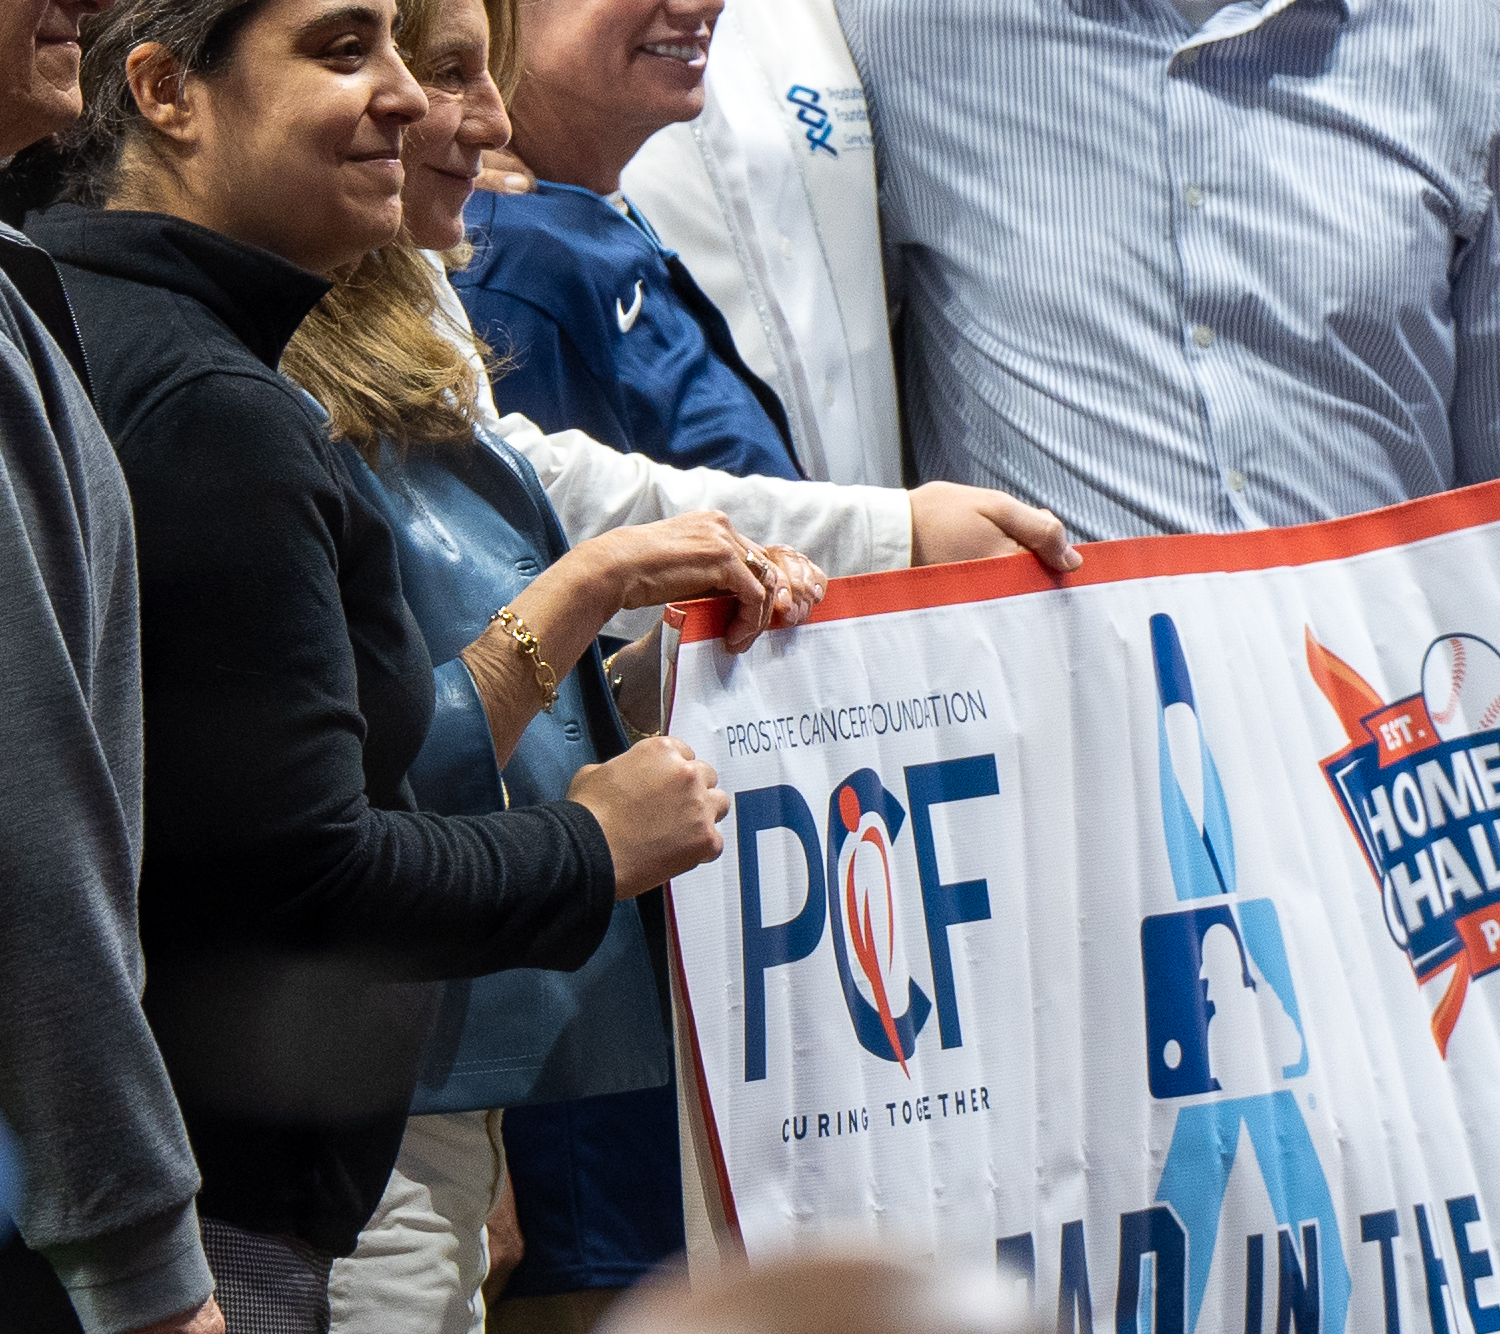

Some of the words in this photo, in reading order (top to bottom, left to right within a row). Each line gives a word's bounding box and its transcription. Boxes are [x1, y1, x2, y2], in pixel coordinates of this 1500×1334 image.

[799, 705, 869, 746] CANCER
[1379, 715, 1425, 751] EST.
[734, 753, 1000, 1083] PCF
[781, 1106, 869, 1143] CURING
[885, 1086, 991, 1127] TOGETHER
